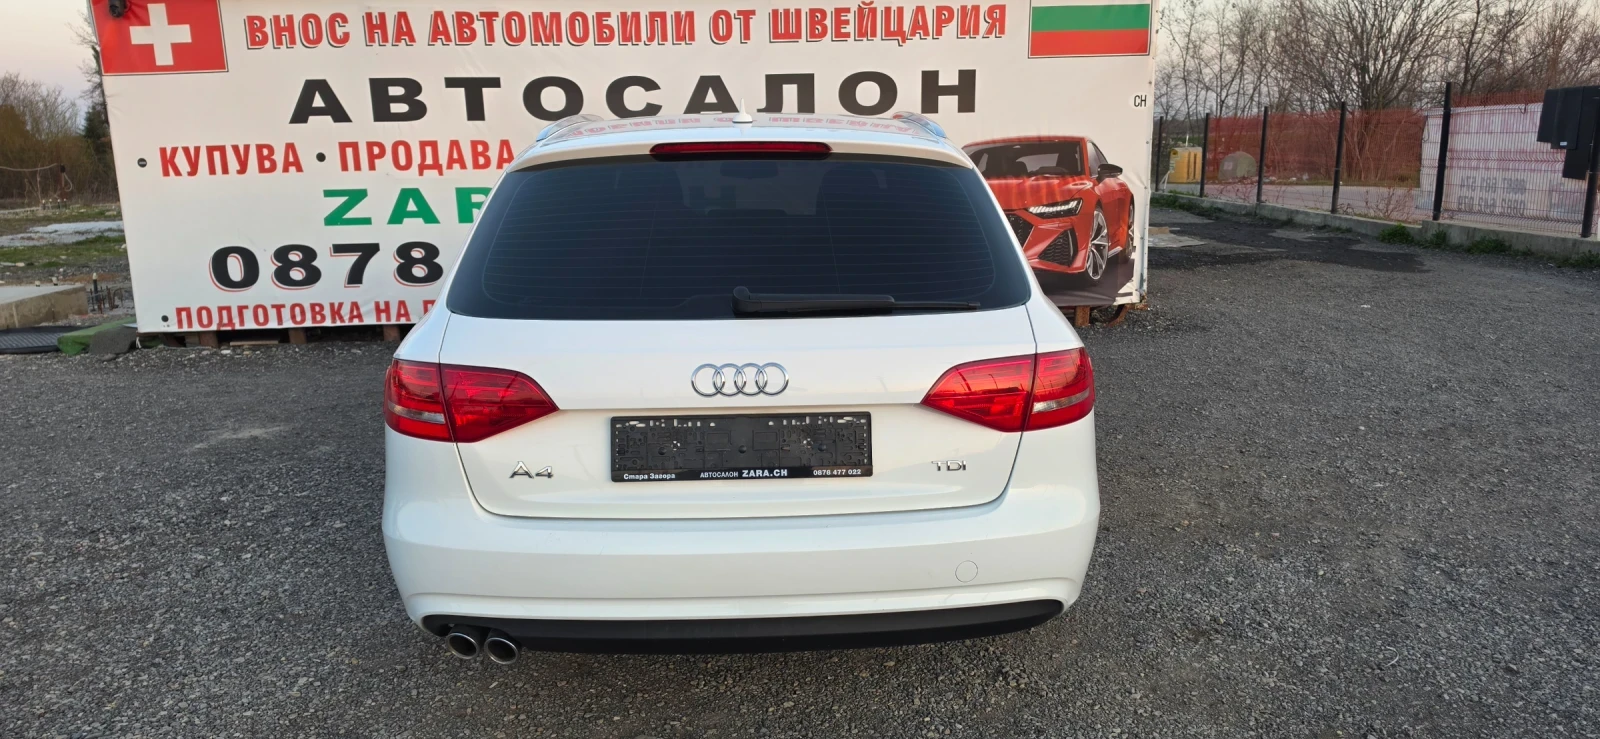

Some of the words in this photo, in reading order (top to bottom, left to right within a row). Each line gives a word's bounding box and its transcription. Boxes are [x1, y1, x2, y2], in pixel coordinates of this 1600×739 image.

[244, 12, 350, 49] ВНОС
[362, 11, 416, 46] НА
[428, 9, 696, 46] АВТОМОБИЛИ
[709, 9, 756, 43] ОТ
[768, 1, 1007, 45] ШВЕЙЦАРИЯ
[289, 69, 977, 124] АВТОСАЛОН
[1134, 95, 1147, 107] CH
[160, 142, 304, 177] КУПУВА
[338, 139, 515, 176] ПРОДАВА
[209, 241, 444, 292] 0878
[175, 301, 365, 331] ПОДГОТОВКА
[374, 300, 412, 323] НА
[509, 461, 554, 479] A4
[742, 469, 788, 477] ZARA.CH
[931, 460, 966, 471] TDI
